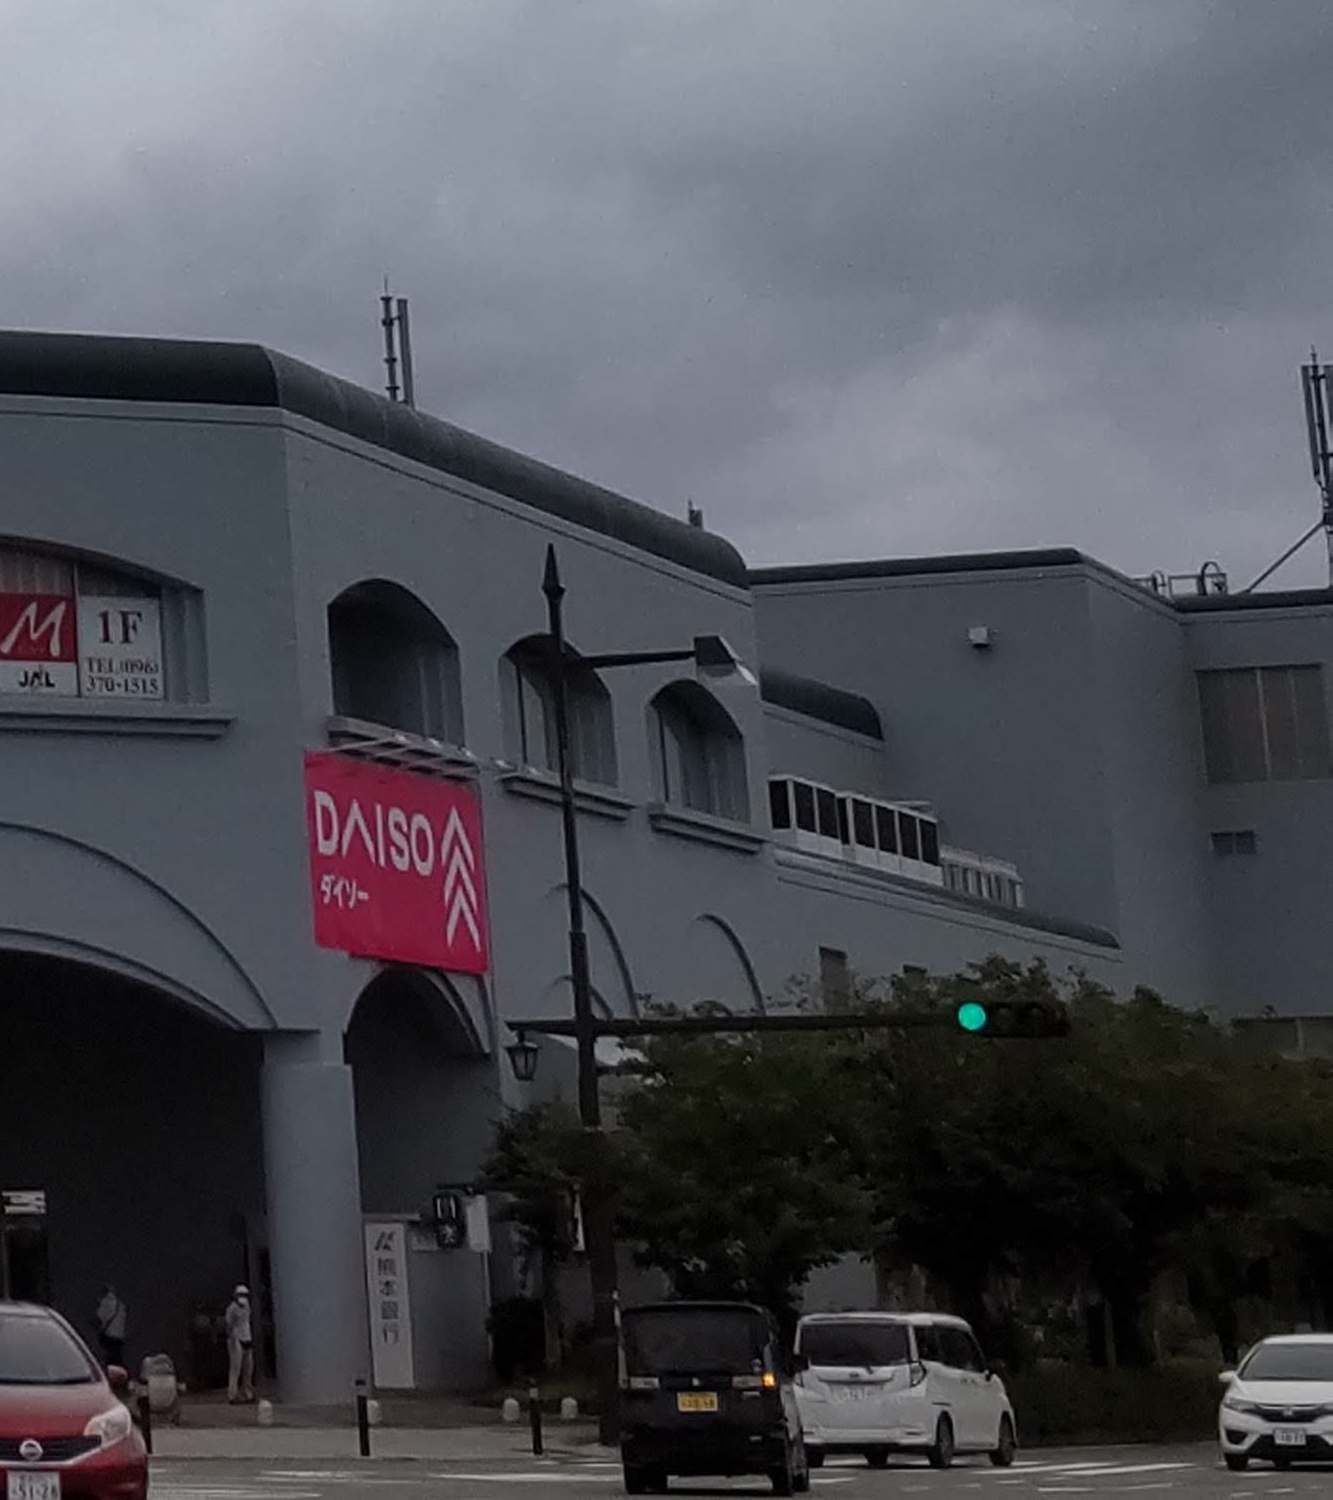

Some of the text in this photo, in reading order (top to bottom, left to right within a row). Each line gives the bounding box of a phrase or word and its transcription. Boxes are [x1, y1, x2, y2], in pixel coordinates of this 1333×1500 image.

[98, 609, 143, 645] 1F
[314, 789, 434, 877] DAISO
[319, 873, 370, 909] ダイソー
